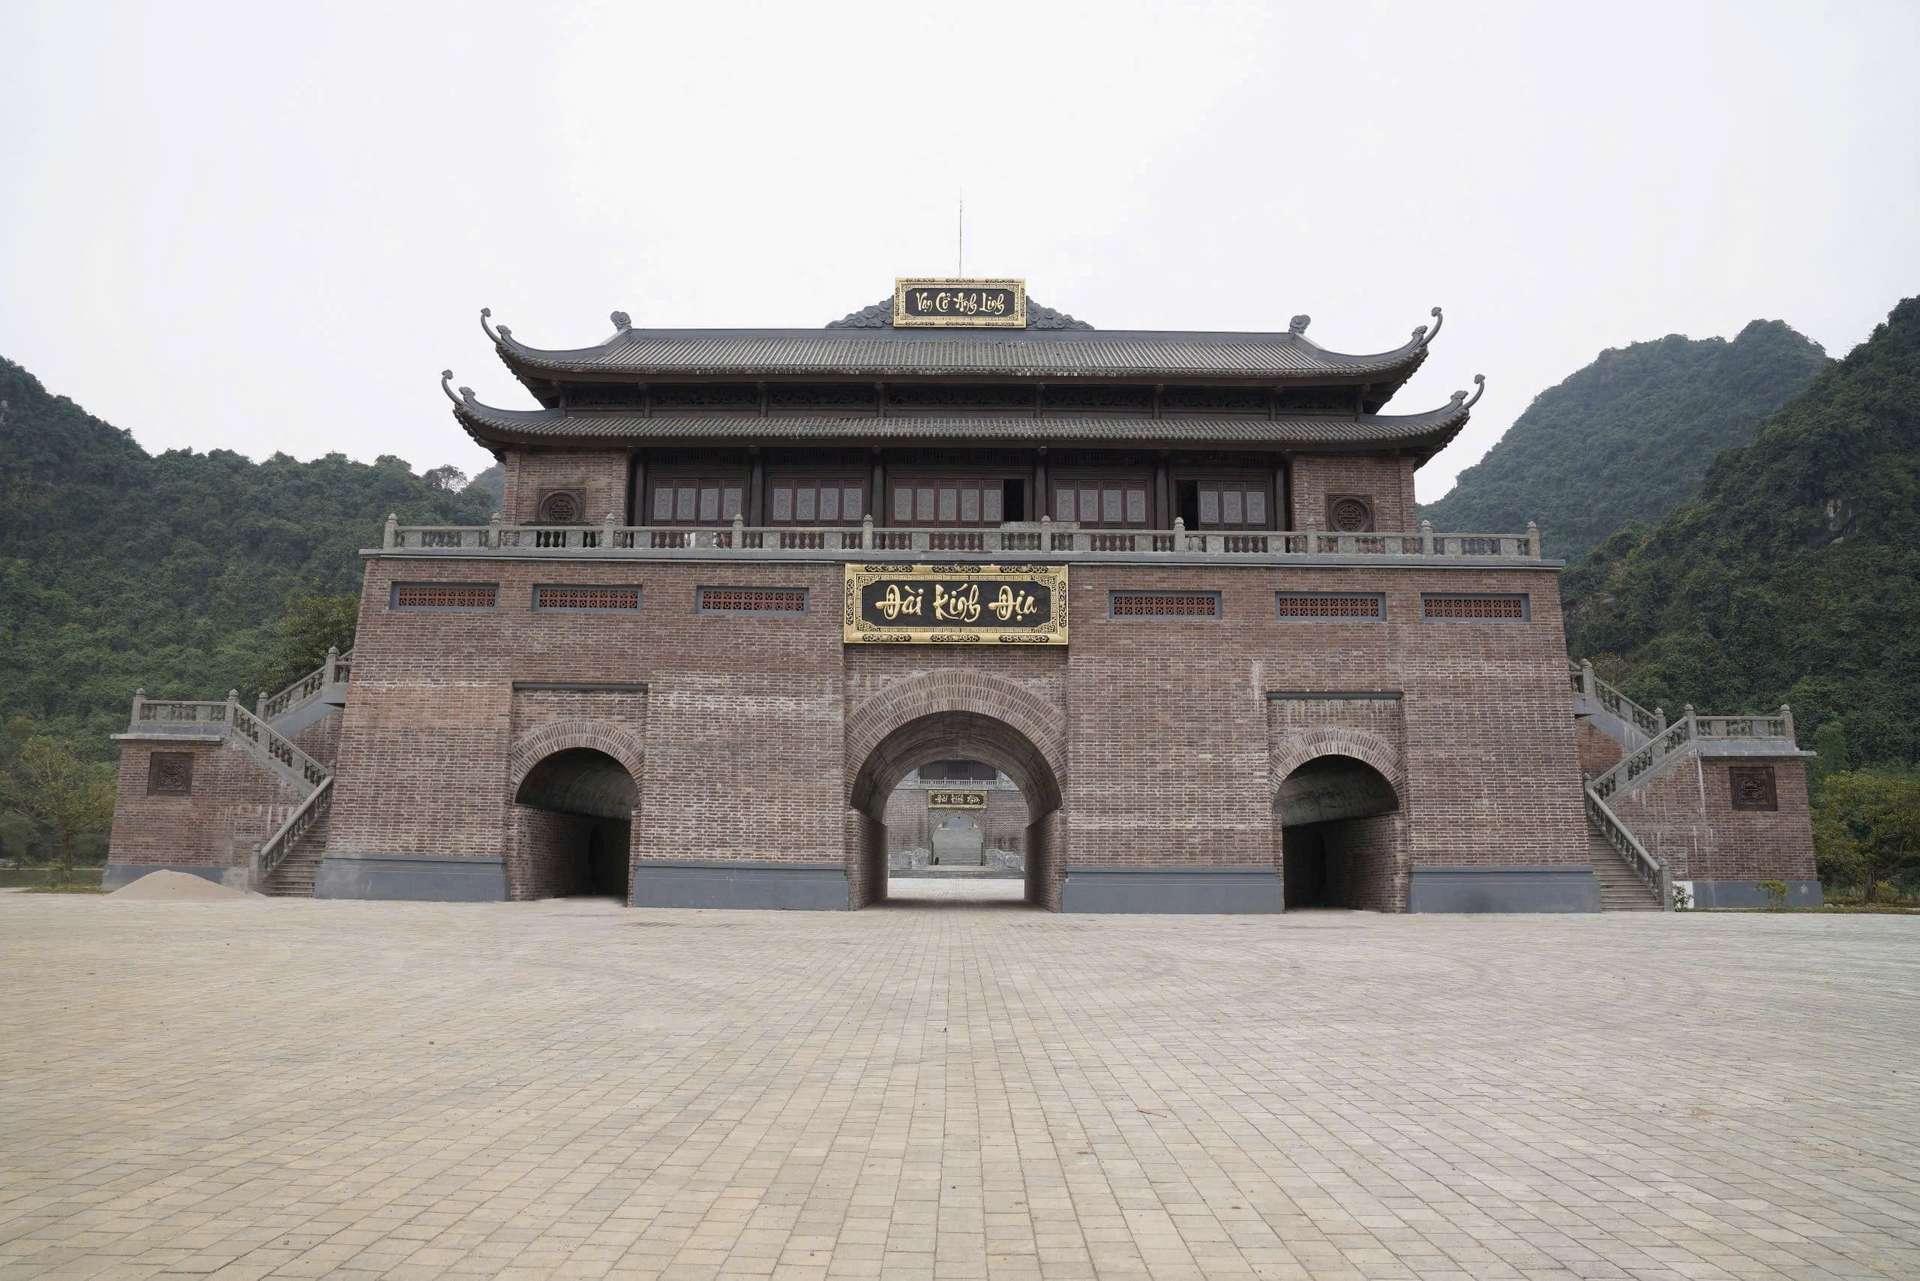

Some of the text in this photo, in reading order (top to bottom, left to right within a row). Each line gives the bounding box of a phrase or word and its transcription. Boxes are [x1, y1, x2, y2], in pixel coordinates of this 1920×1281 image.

[916, 292, 1005, 315] Vạn Cổ Anh Linh
[875, 583, 1038, 622] Đài Kính Địa
